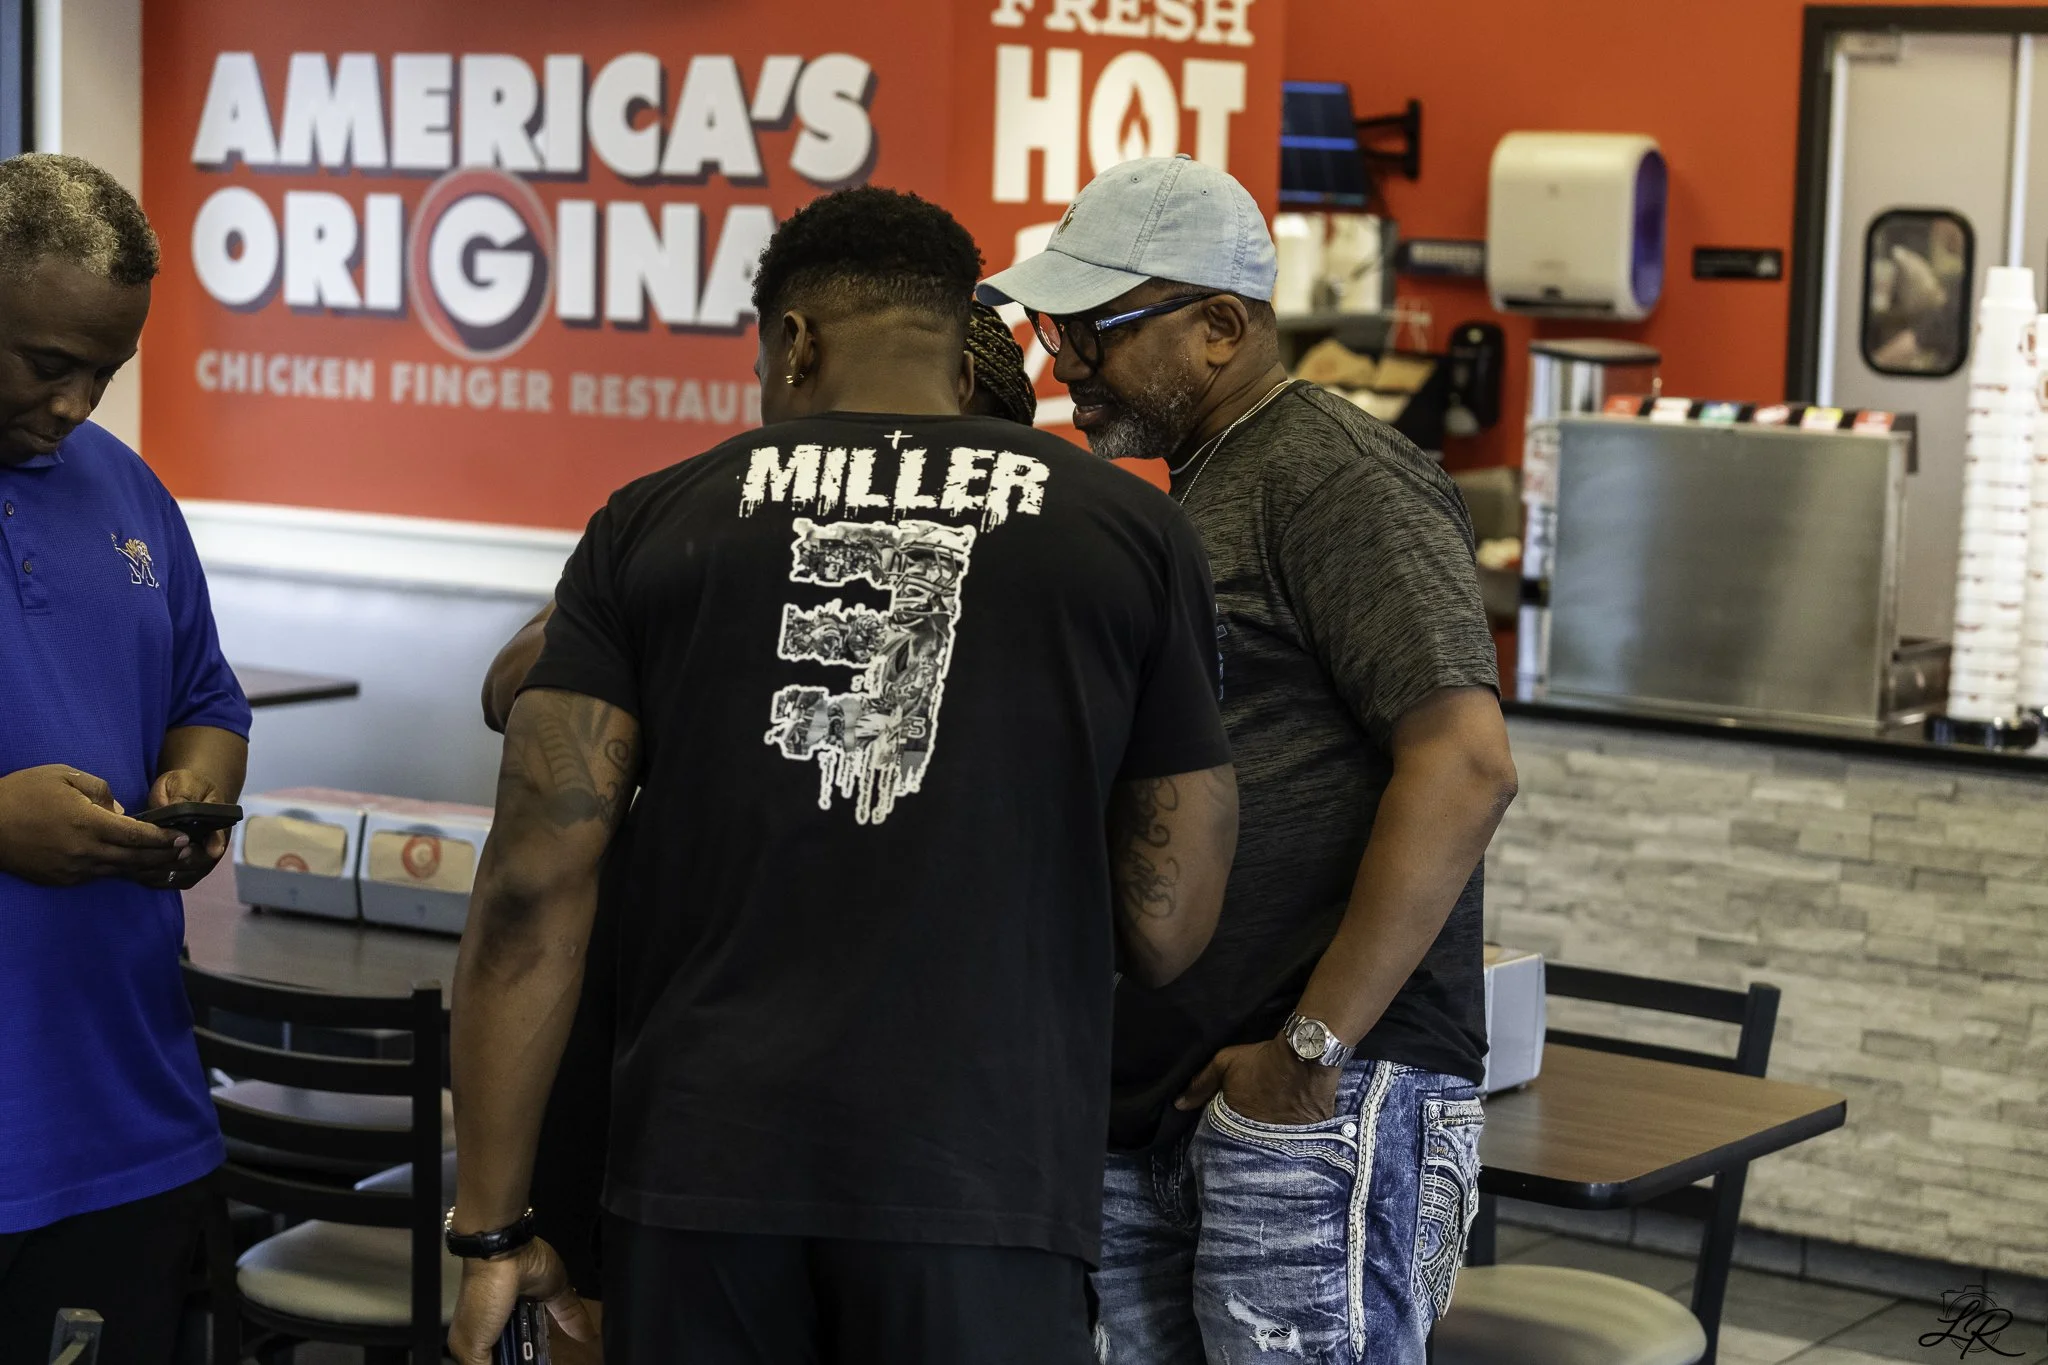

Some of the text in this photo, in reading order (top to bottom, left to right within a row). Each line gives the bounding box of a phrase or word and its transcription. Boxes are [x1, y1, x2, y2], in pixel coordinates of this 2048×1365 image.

[991, 0, 1255, 47] FRESH
[191, 51, 876, 186] AMERICA'S
[992, 44, 1248, 204] HOT
[191, 186, 778, 330] ORIGINA
[195, 350, 762, 424] CHICKEN FINGER RESTAUR
[738, 444, 1051, 533] MILLER
